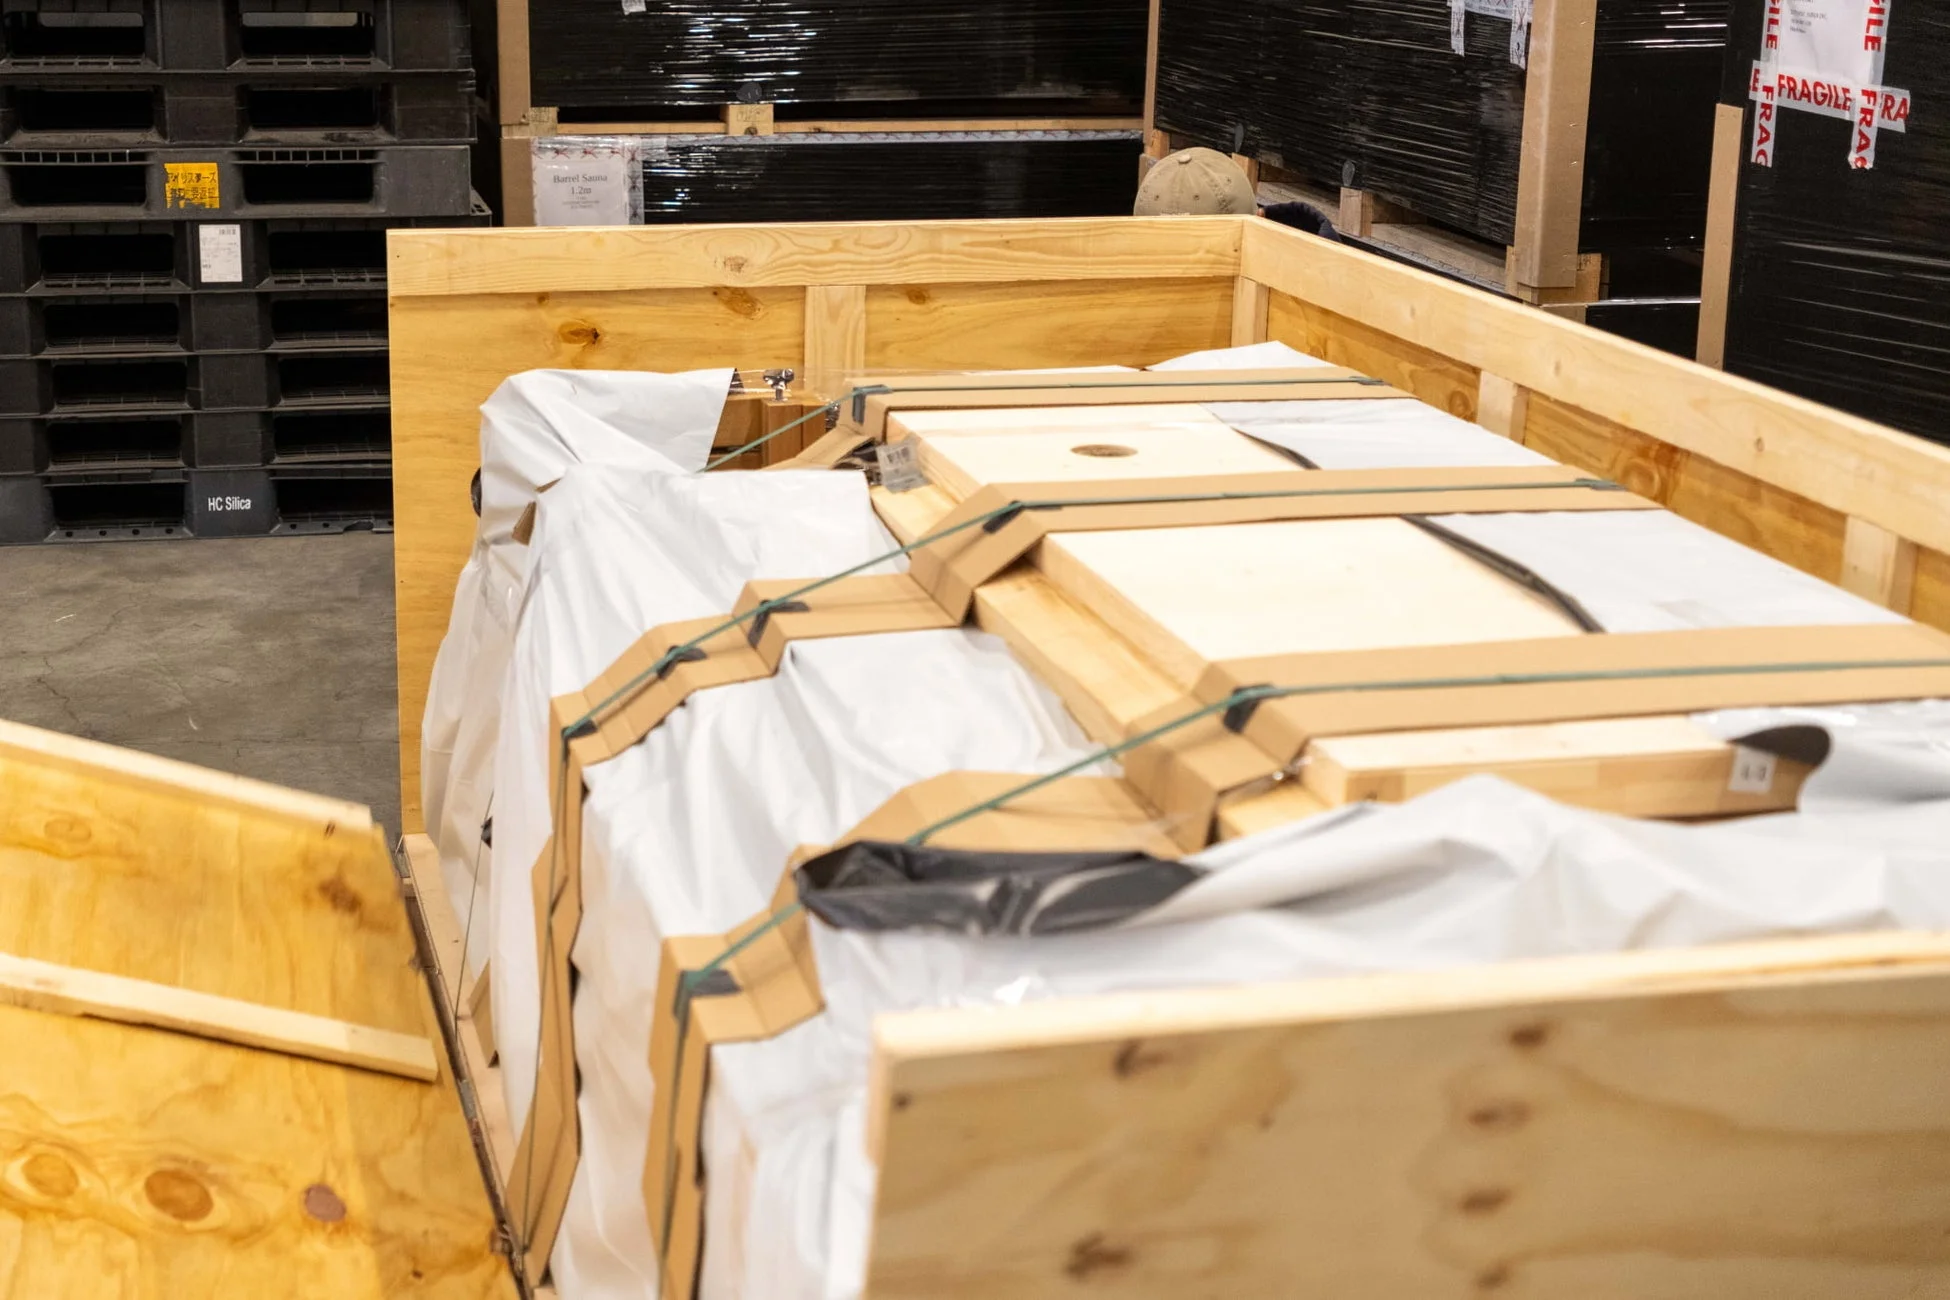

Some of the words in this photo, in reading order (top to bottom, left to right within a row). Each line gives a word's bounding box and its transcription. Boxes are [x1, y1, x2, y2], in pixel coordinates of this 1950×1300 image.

[1777, 74, 1852, 111] FRAGILE
[1880, 92, 1909, 122] RA
[553, 174, 580, 184] Barrel
[582, 174, 608, 183] Sauna
[571, 186, 592, 196] 1.2m
[208, 497, 223, 511] HC
[225, 496, 251, 511] Silica
